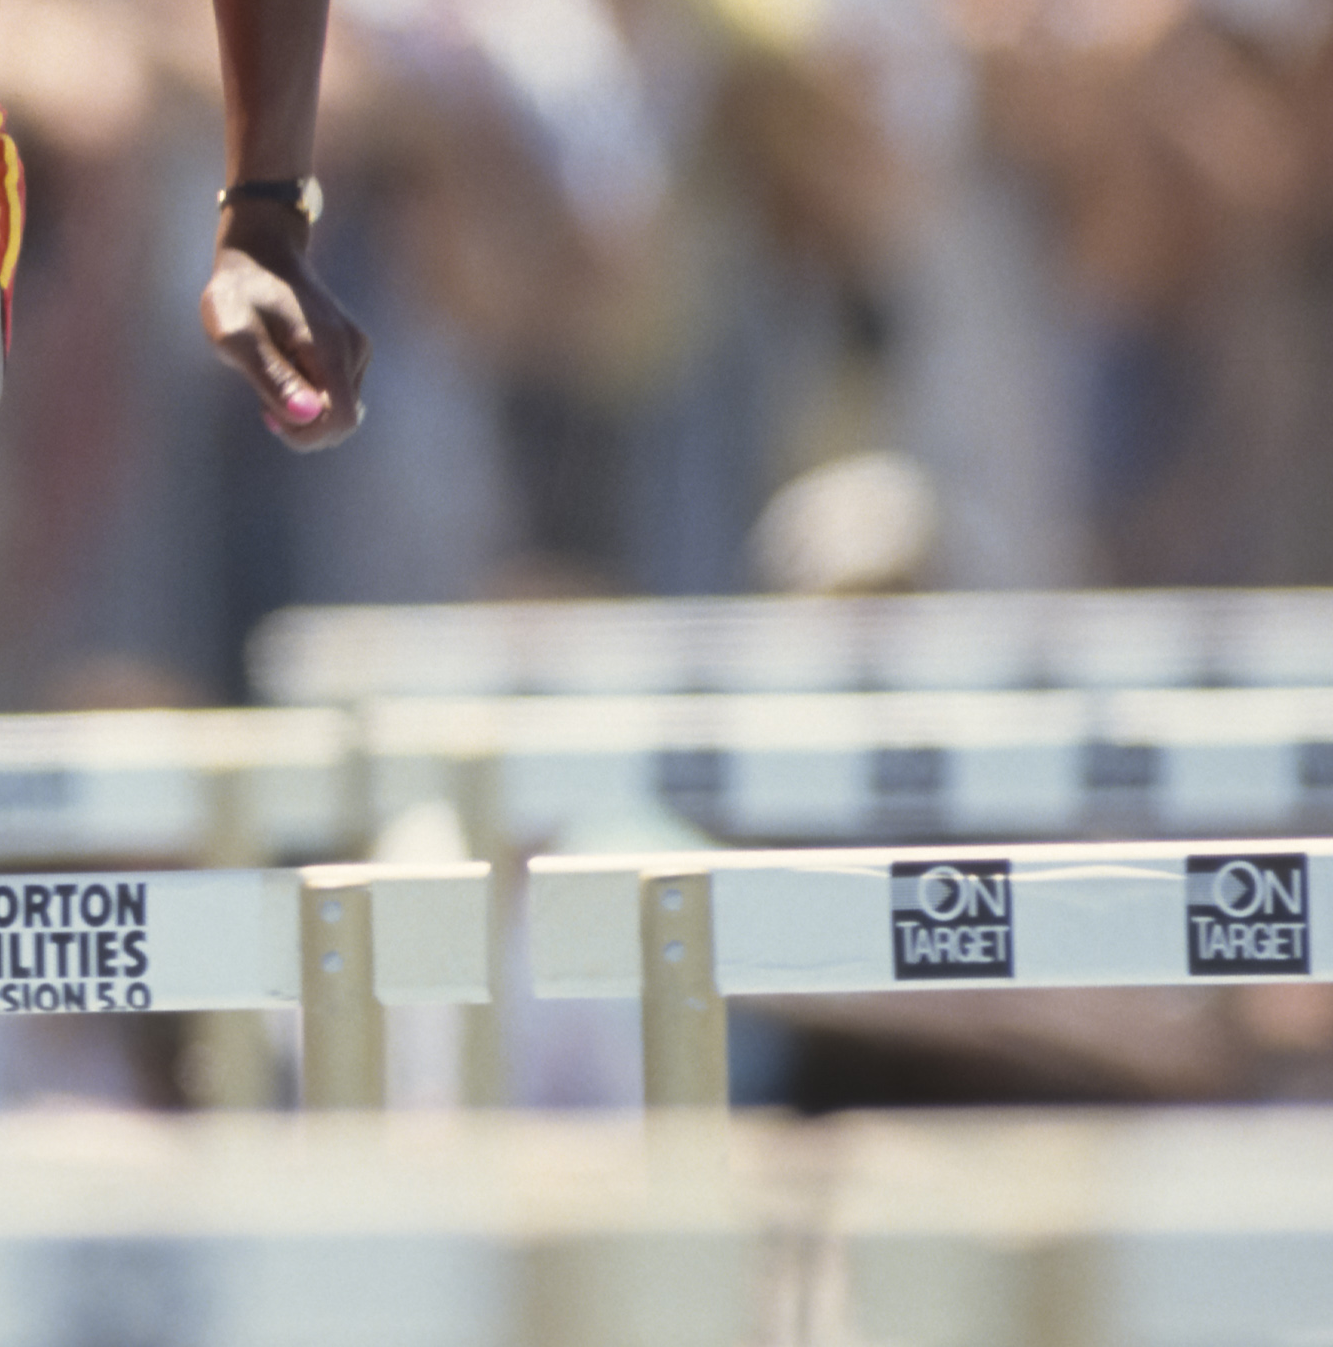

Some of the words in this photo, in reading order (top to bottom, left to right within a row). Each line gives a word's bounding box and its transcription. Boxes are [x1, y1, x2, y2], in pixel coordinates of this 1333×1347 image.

[896, 920, 1011, 964] TARGET
[1191, 915, 1305, 960] TARGET
[97, 981, 152, 1012] 5.0
